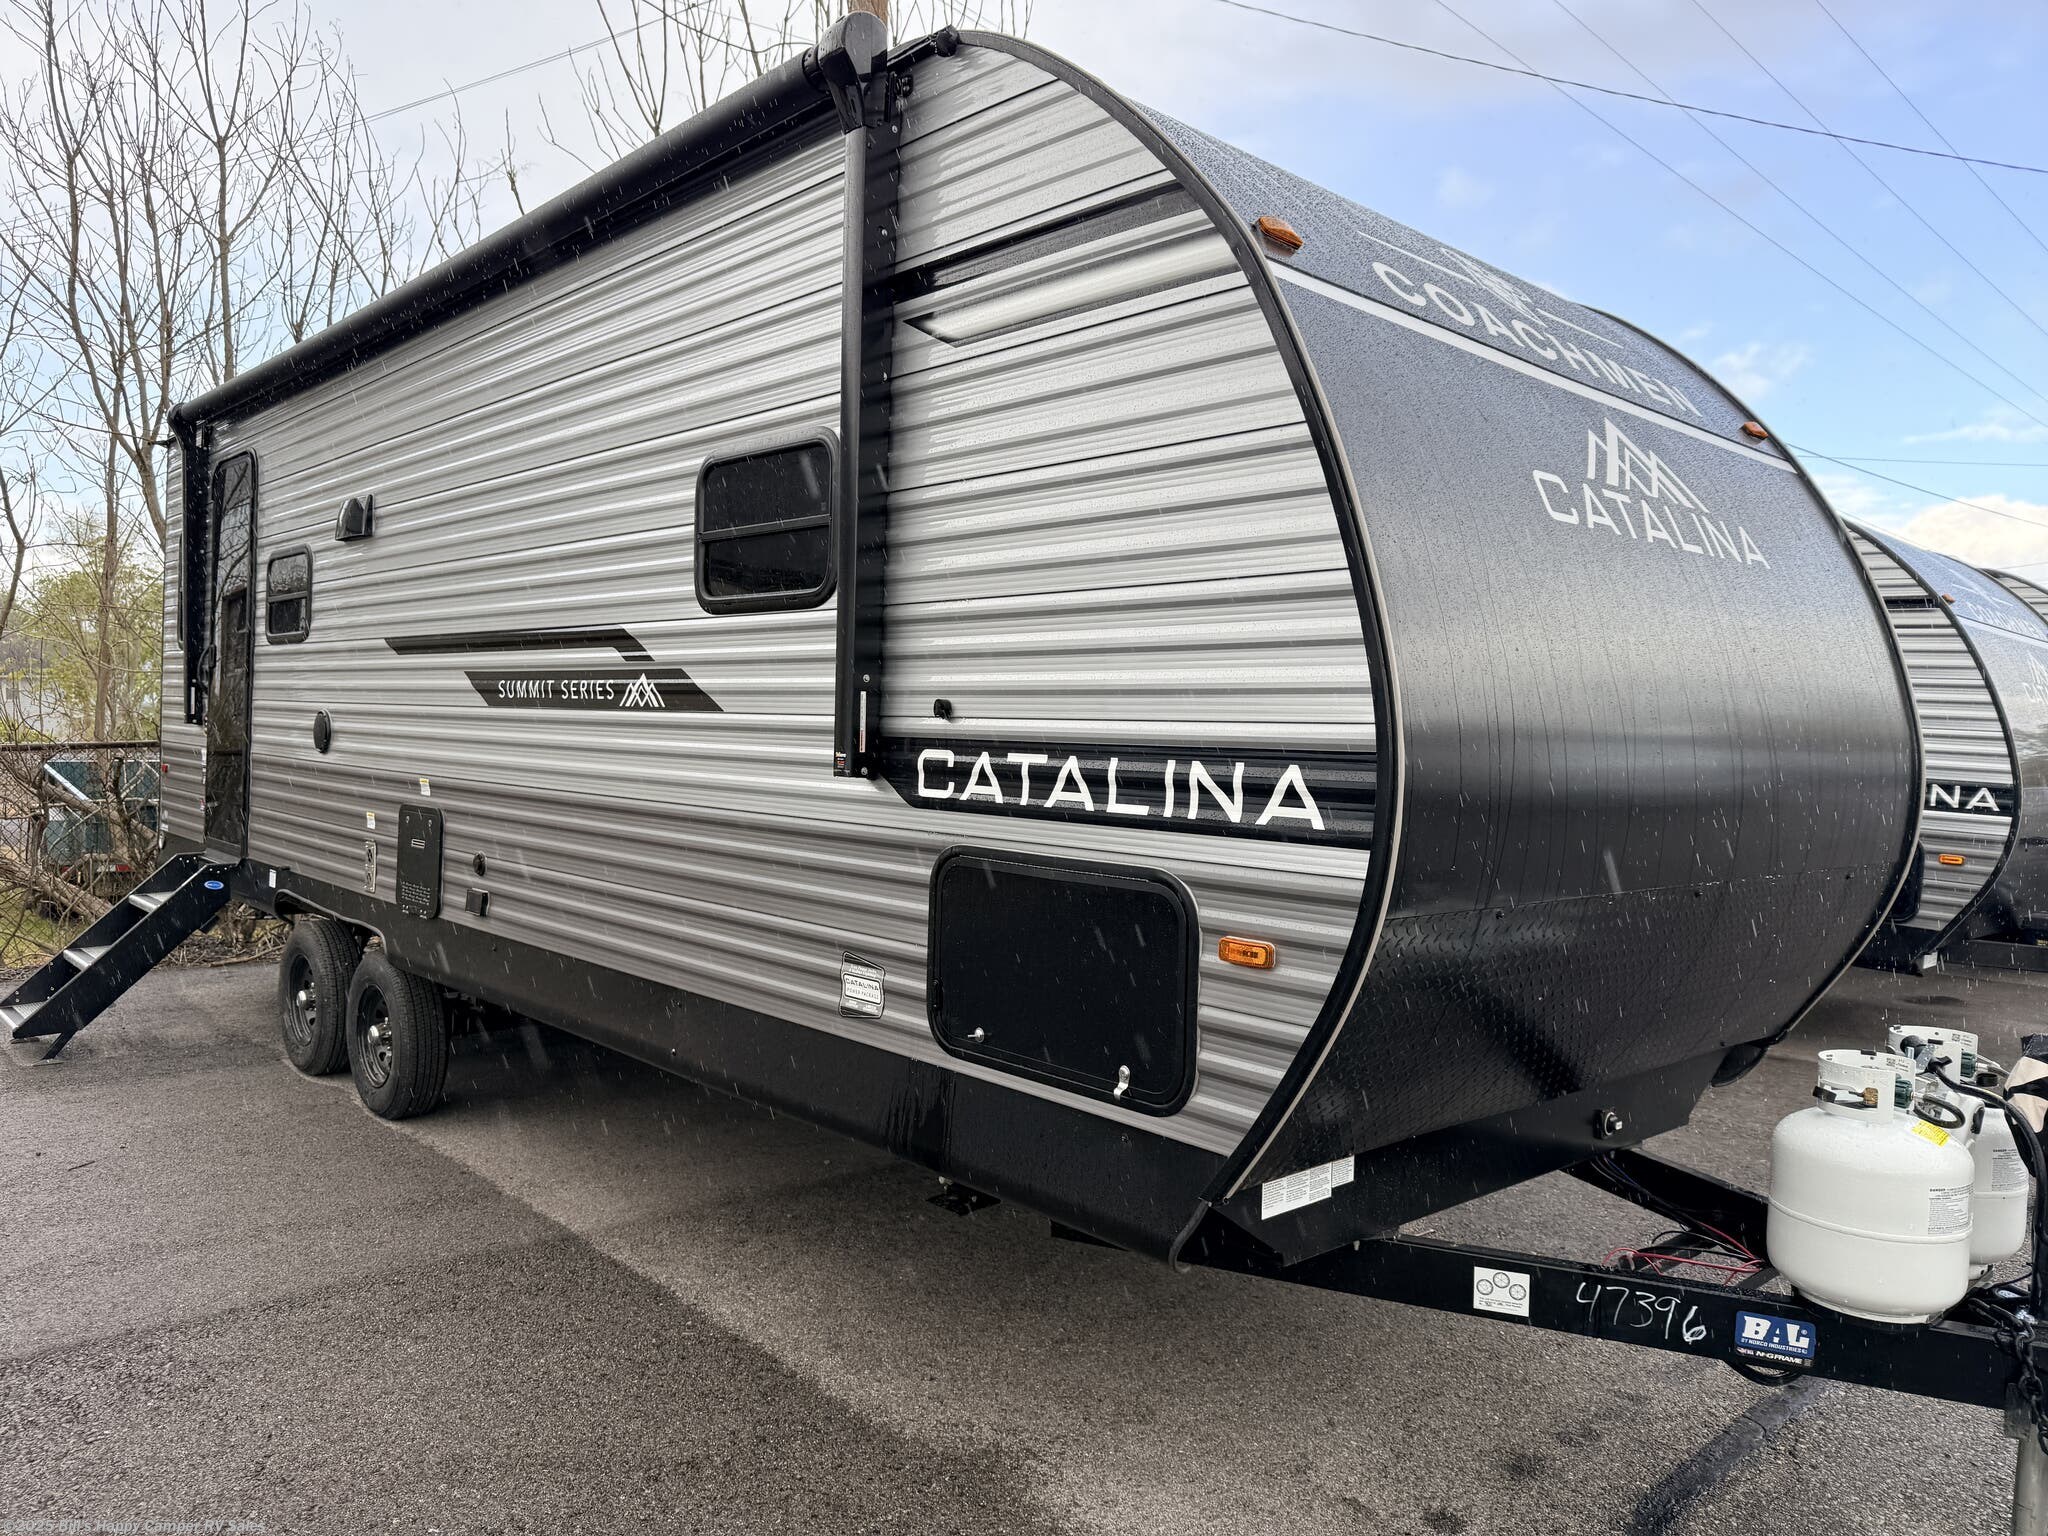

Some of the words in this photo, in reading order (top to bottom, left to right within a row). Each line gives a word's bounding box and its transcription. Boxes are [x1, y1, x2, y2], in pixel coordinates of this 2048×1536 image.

[1373, 262, 1703, 418] COACHMEN
[1533, 469, 1771, 570] CATALINA
[499, 679, 555, 699] SUMMIT
[561, 679, 615, 701] SERIES
[917, 749, 1326, 831] CATALINA
[1576, 1281, 1707, 1345] 47396
[1741, 1315, 1810, 1349] BAL
[1768, 1342, 1802, 1353] INDUSTRIES
